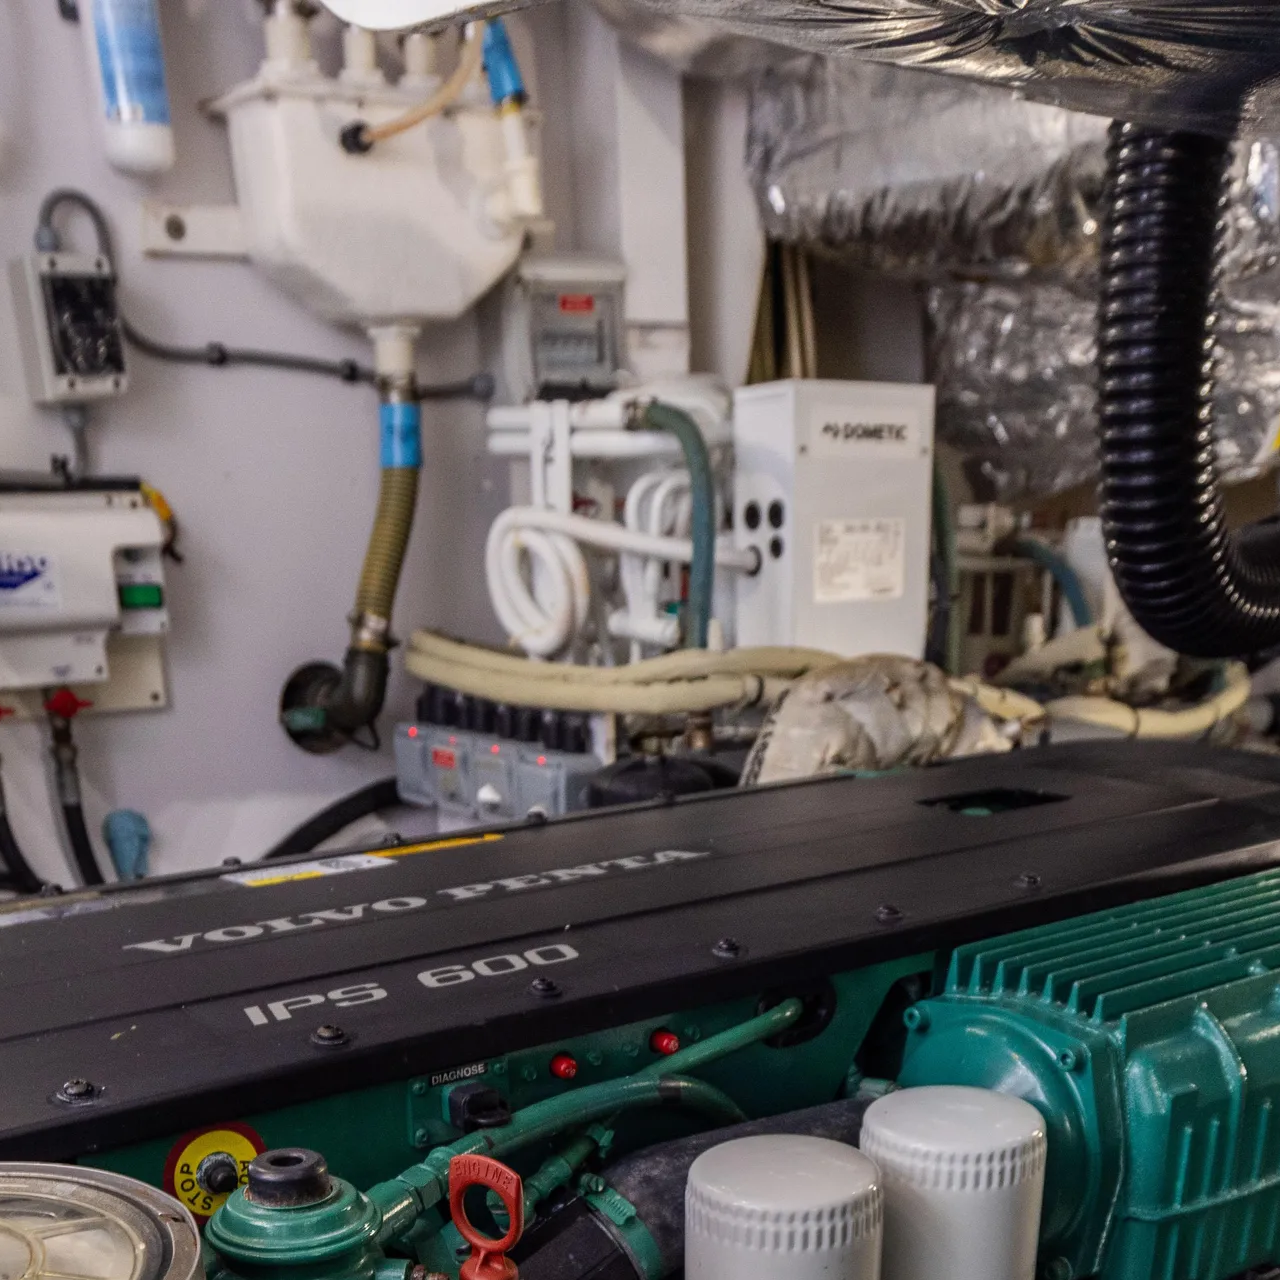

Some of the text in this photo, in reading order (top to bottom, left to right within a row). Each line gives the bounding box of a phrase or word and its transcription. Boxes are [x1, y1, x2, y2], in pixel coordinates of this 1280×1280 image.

[122, 847, 711, 954] VOLVO PENTA
[243, 943, 580, 1027] IPS 600
[431, 1062, 485, 1086] DIAGNOSE
[180, 1163, 214, 1211] STOP
[454, 1159, 513, 1190] ENGINE
